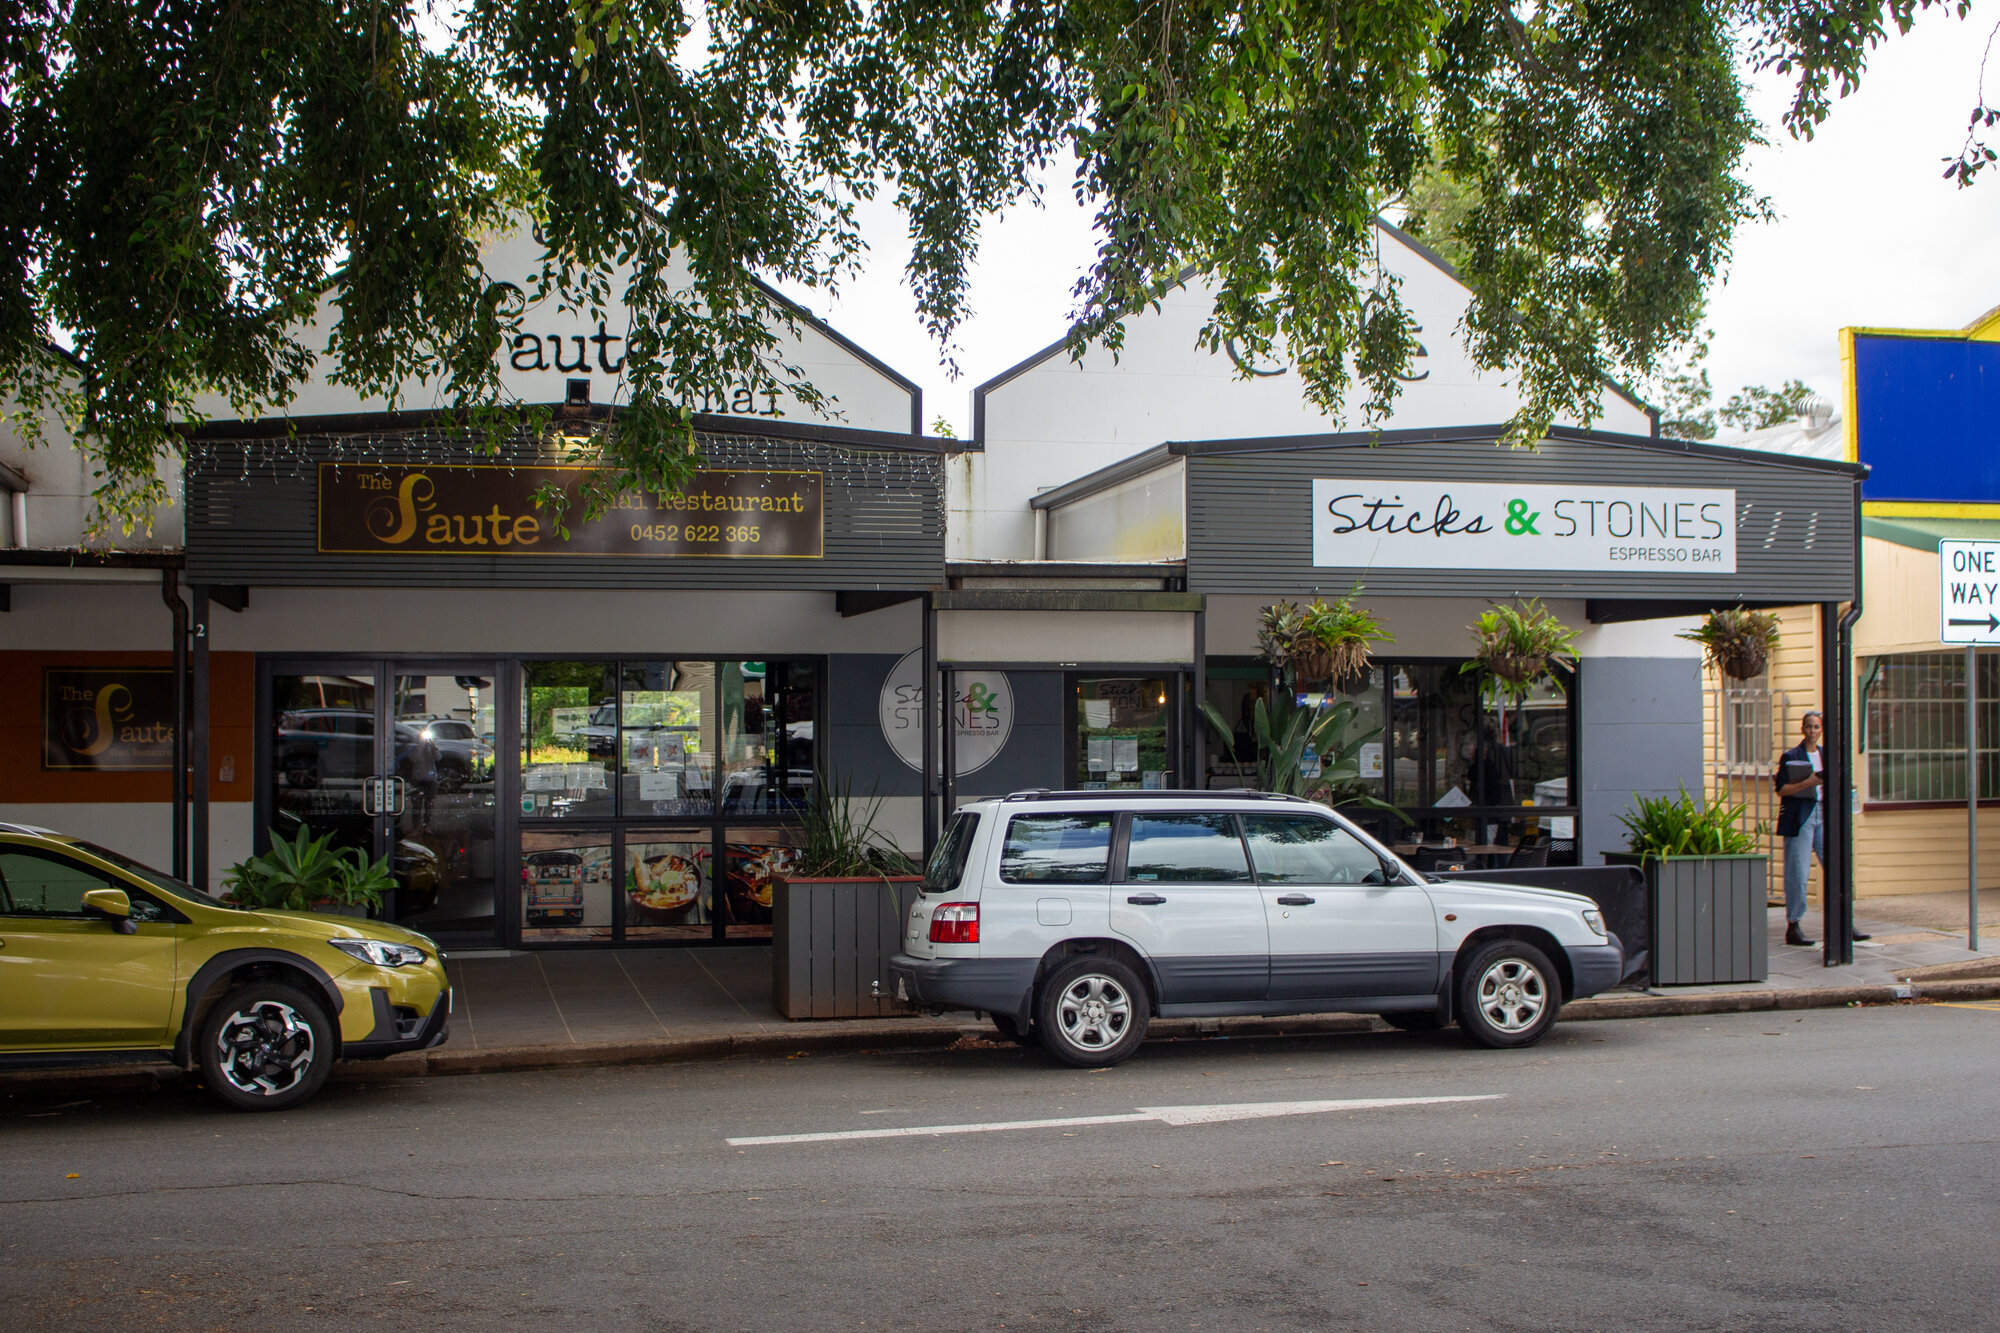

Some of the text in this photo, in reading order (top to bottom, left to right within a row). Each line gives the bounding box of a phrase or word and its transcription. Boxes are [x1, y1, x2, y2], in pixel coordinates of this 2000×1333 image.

[357, 473, 393, 490] The
[365, 473, 540, 546] Saute
[1328, 494, 1723, 540] Sticks & STONES
[630, 524, 761, 543] 0452 622 365
[1609, 547, 1722, 562] ESPRESSO BAR
[1953, 550, 1996, 573] ONE
[1951, 582, 1998, 605] WAY
[196, 623, 206, 638] 2
[59, 686, 94, 701] The
